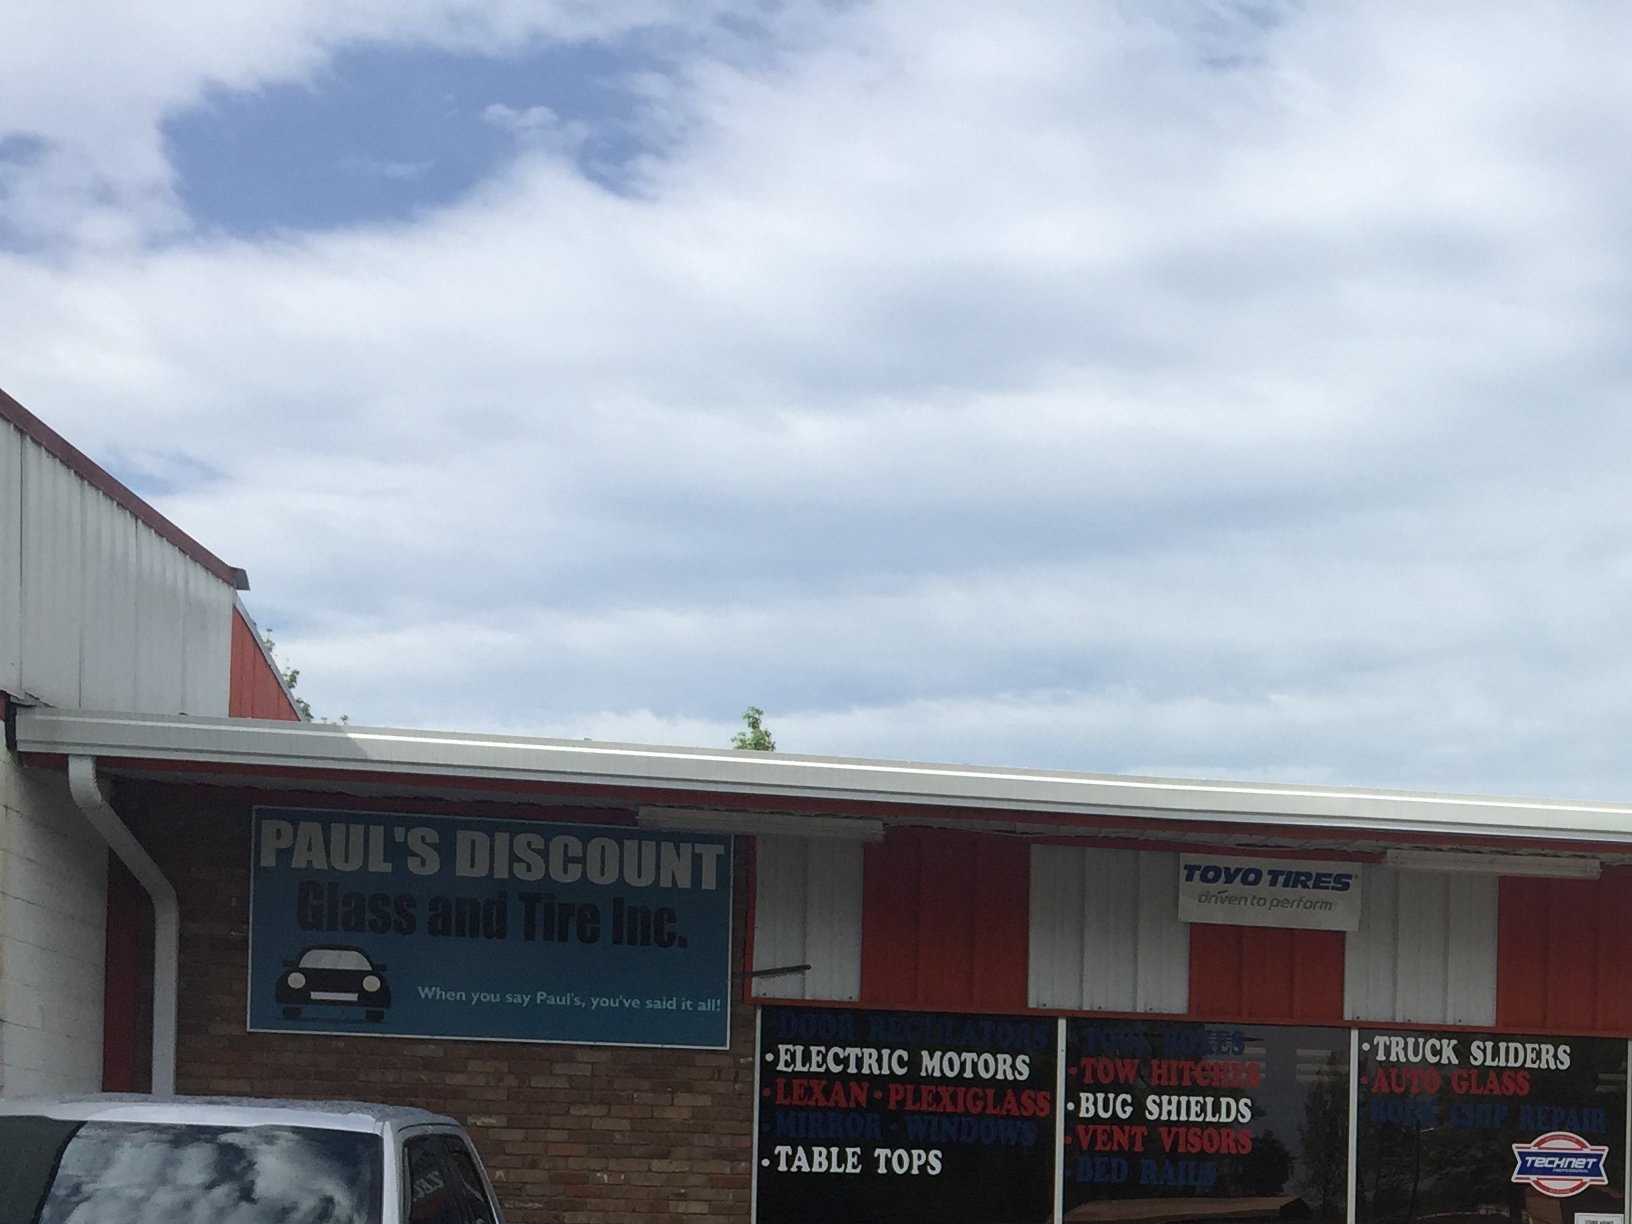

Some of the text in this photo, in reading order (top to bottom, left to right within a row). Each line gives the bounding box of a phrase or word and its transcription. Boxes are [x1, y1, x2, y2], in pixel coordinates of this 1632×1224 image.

[260, 820, 724, 890] PAUL'S DISCOUNT
[1184, 864, 1353, 892] TOYO TIRES
[297, 880, 688, 948] Glass and Tire Inc.
[1198, 890, 1333, 911] driven to perform
[417, 986, 721, 1012] When you say Paul's, you've said it all!
[776, 1044, 1030, 1081] ELECTRIC MOTORS
[1374, 1035, 1571, 1070] TRUCK SLIDERS
[1080, 1057, 1261, 1088] TOW HITCHES
[1372, 1067, 1531, 1096] AUTO GLASS
[776, 1078, 1050, 1117] LEXAN PLEXIGLASS
[1079, 1092, 1252, 1123] BUG SHIELDS
[905, 1116, 1038, 1147] WINDOWS
[1076, 1125, 1253, 1155] VENT VISORS
[774, 1146, 942, 1175] TABLE TOPS
[1077, 1157, 1217, 1187] BED RAILS
